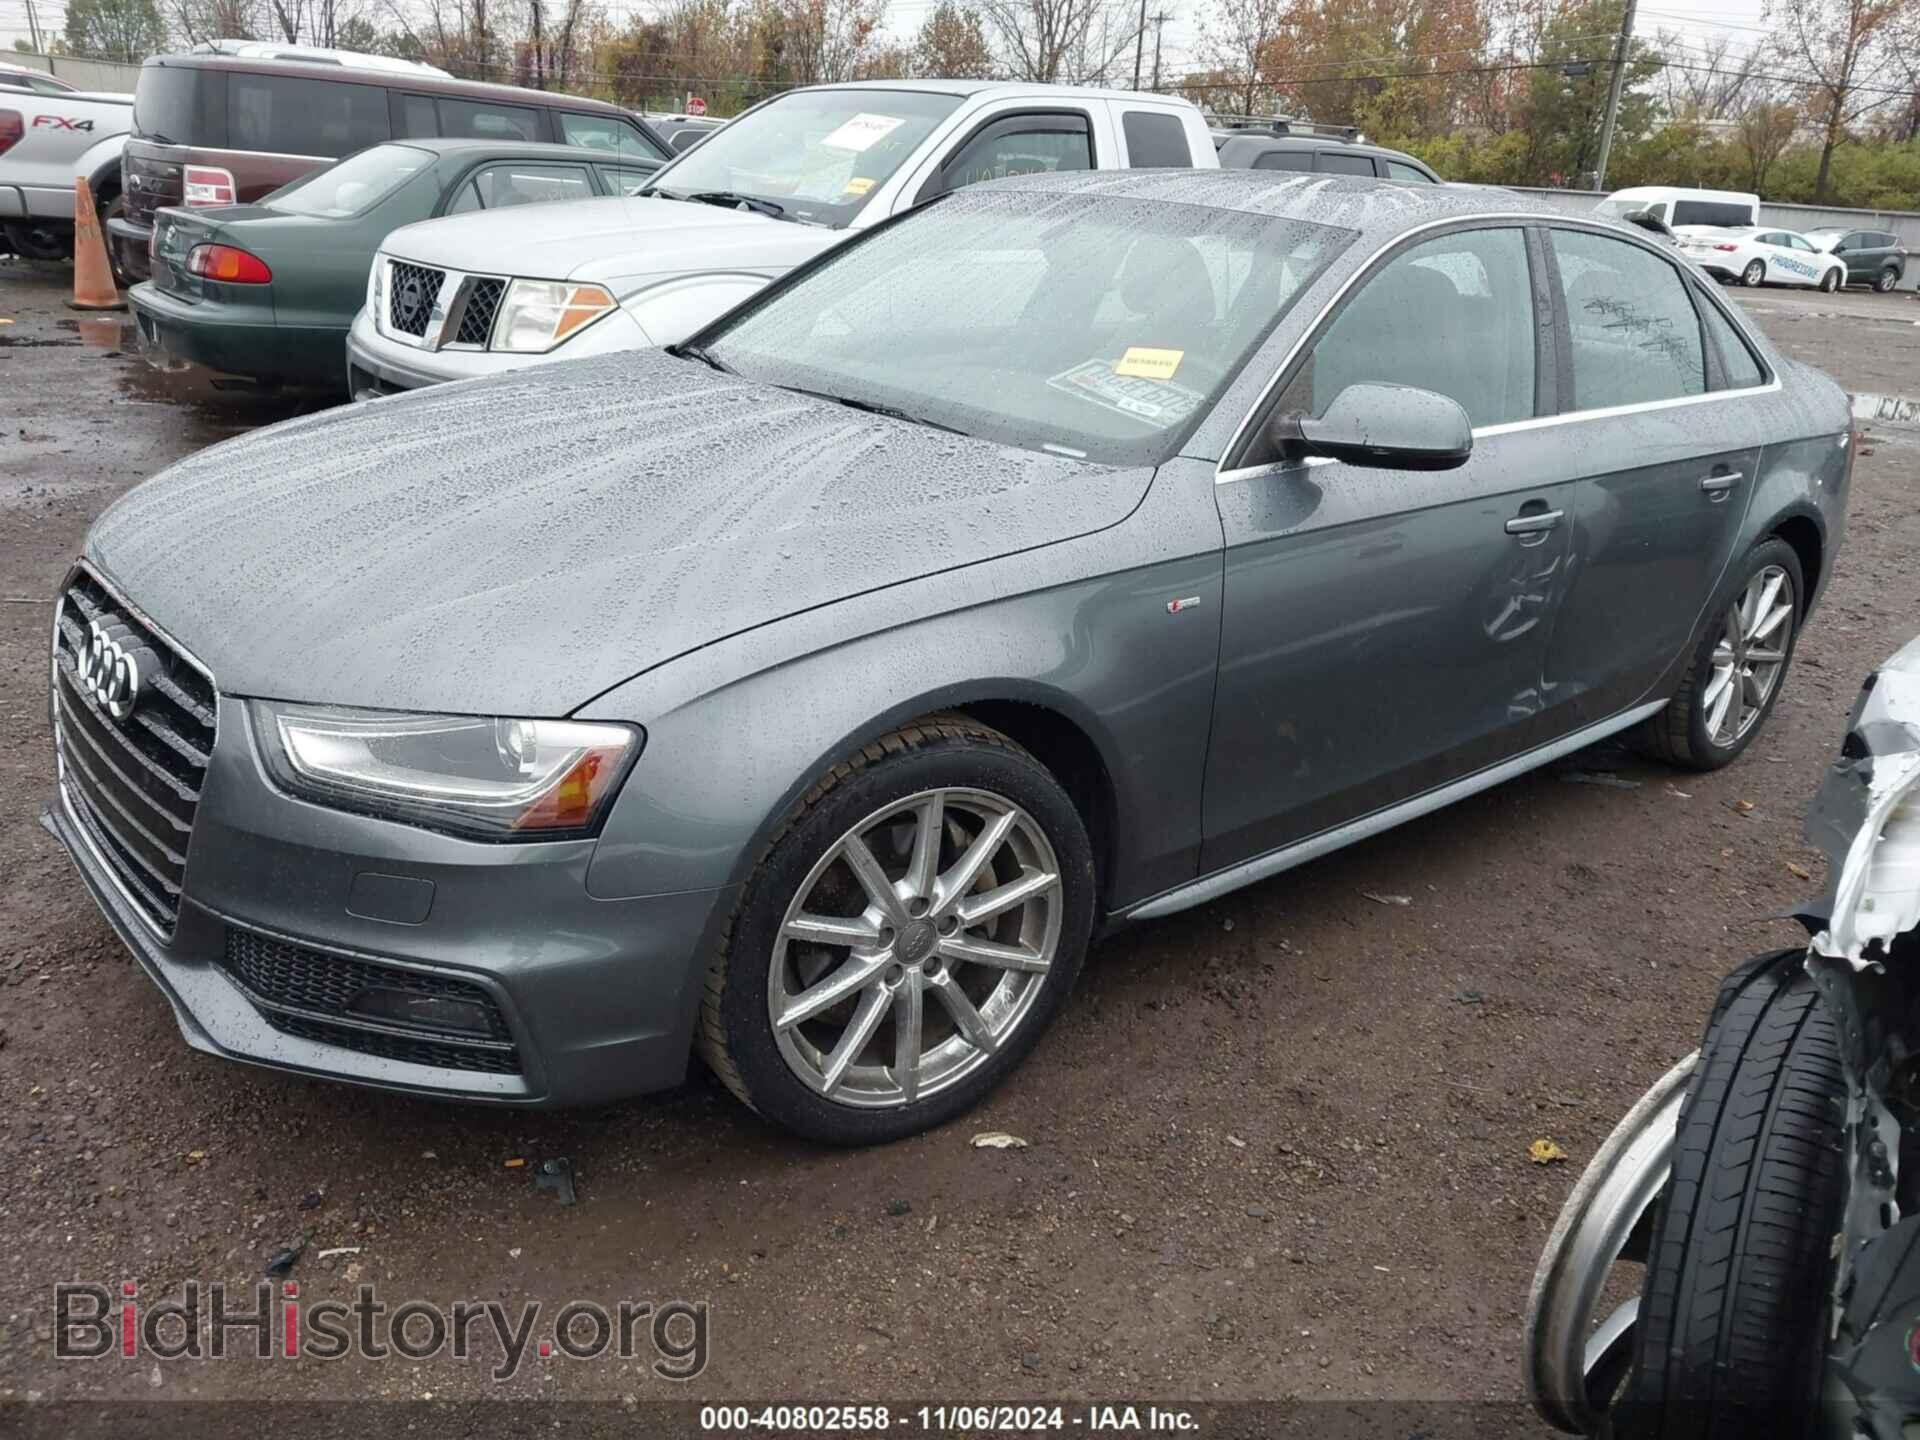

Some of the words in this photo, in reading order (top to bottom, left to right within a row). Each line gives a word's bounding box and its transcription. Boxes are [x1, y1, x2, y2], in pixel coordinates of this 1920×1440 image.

[687, 103, 705, 114] STOP
[32, 115, 94, 131] FX4
[1769, 254, 1820, 279] PROGRESSIVE
